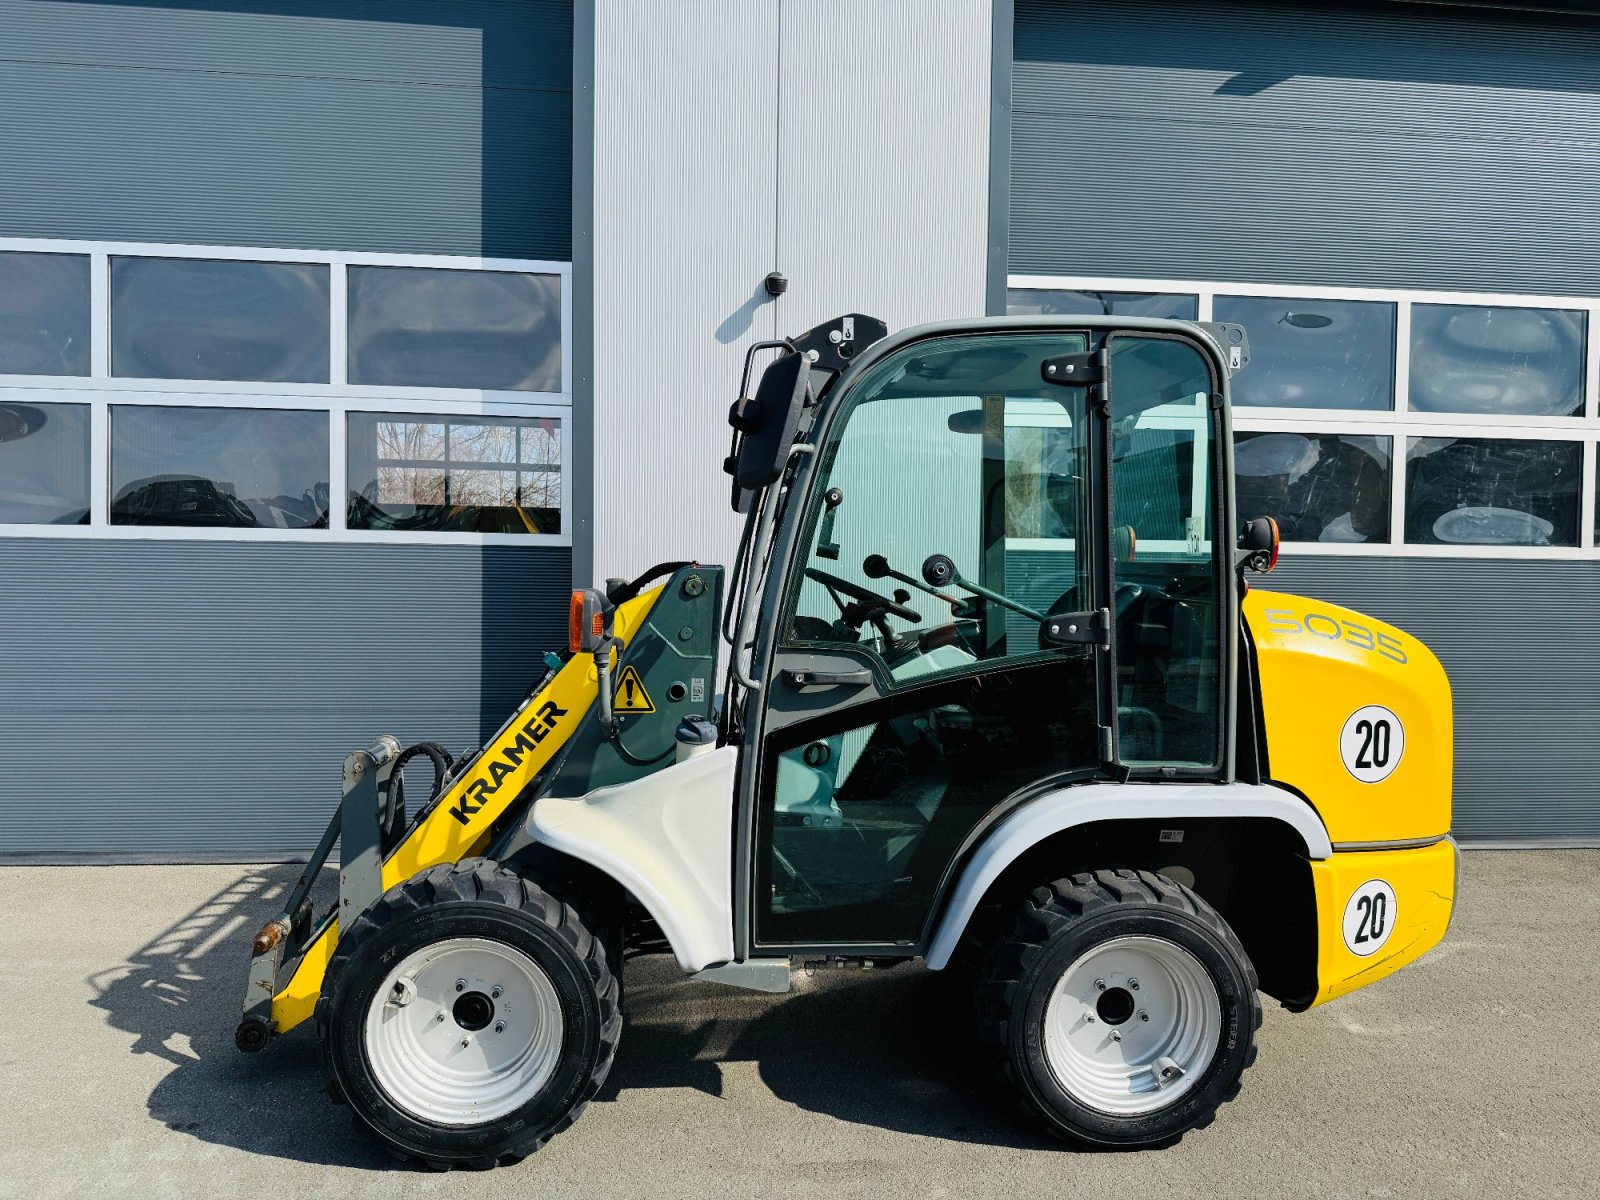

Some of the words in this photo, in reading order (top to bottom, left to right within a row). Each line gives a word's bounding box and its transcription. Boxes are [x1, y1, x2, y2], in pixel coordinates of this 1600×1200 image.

[1264, 608, 1408, 665] 5035
[448, 700, 569, 826] KRAMER
[1355, 719, 1391, 769] 20
[1354, 891, 1387, 944] 20
[1226, 1004, 1239, 1050] STEER
